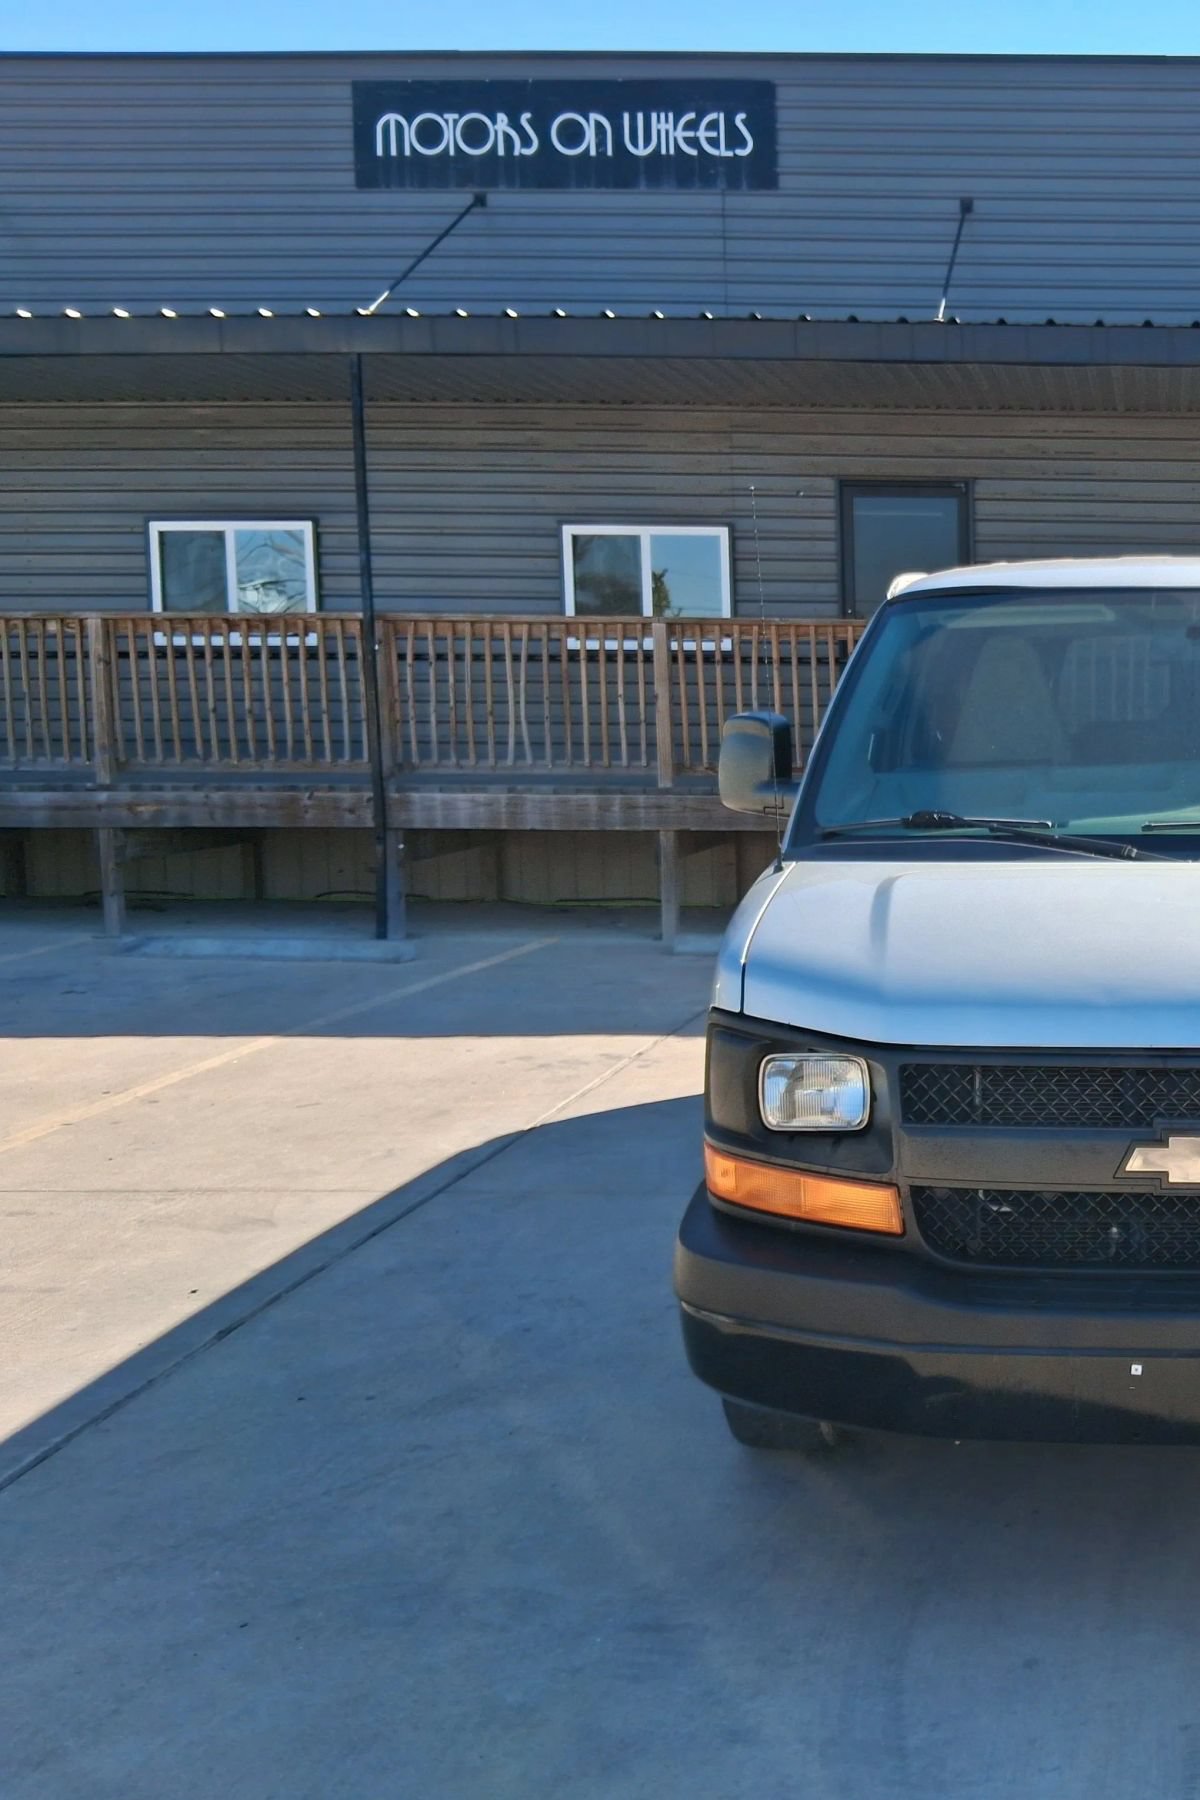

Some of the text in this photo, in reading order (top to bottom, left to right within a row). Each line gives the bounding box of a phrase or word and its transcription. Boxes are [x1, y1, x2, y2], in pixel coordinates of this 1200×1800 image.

[376, 112, 754, 157] MOTORS ON WHEELS
